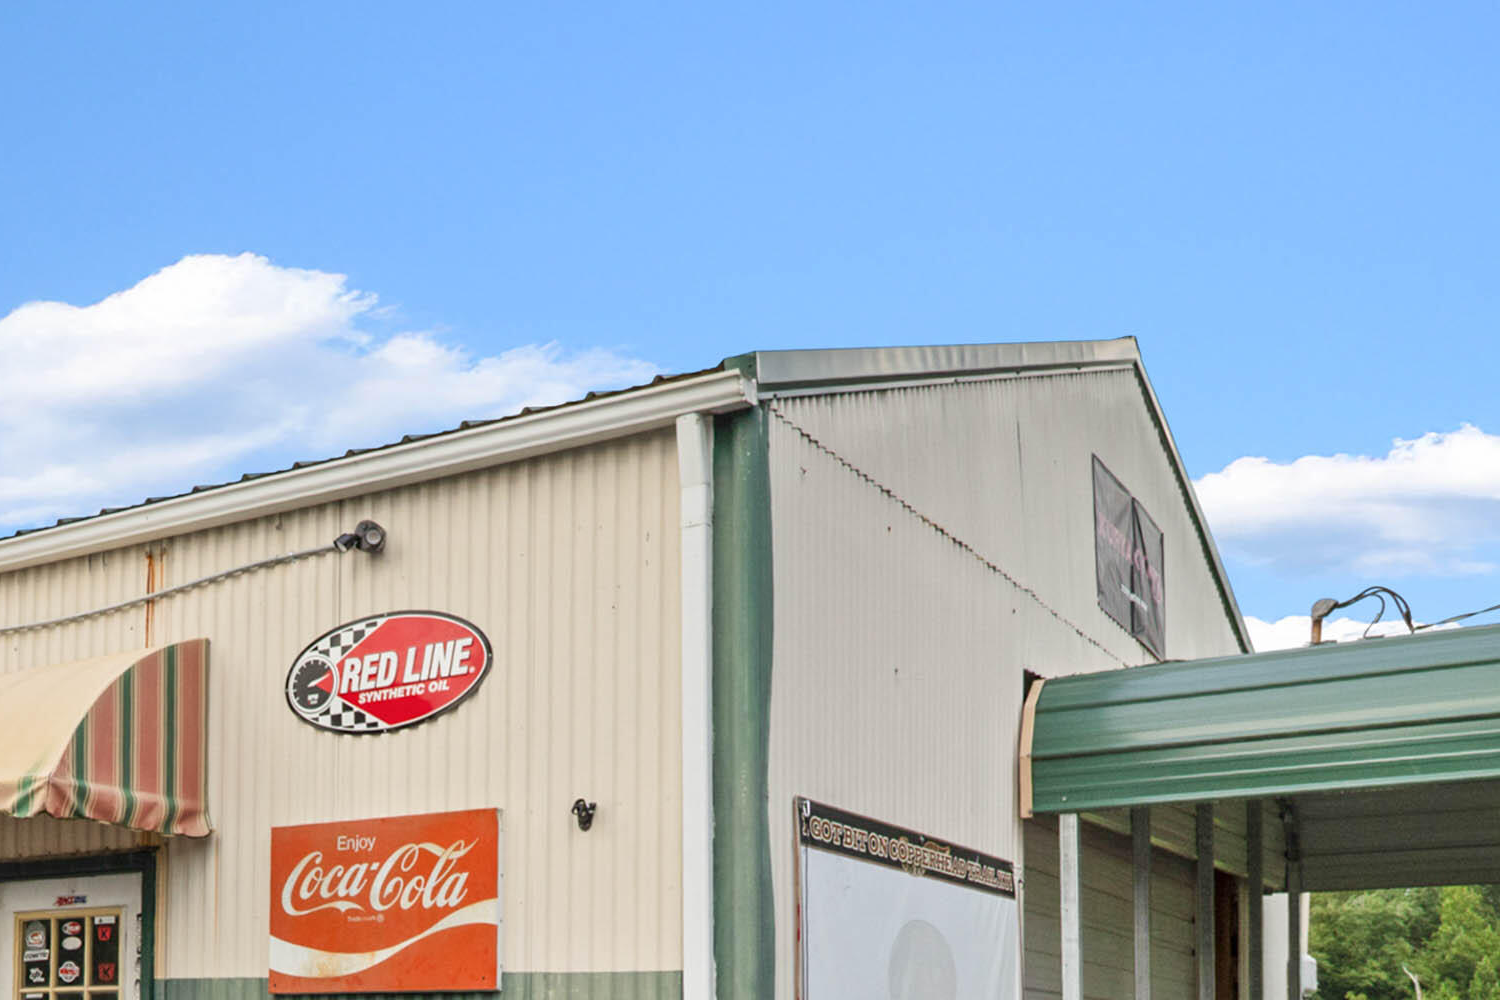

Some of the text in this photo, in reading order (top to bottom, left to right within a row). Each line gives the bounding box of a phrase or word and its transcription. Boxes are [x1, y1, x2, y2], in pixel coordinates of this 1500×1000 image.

[340, 651, 399, 694] RED
[358, 680, 450, 705] SYNTHETIC OIL
[337, 835, 376, 852] Enjoy
[810, 815, 842, 846] GOT
[843, 825, 868, 852] BIT
[868, 832, 888, 858] ON
[889, 838, 966, 879] COPPERHEAD
[281, 837, 479, 916] Coca-Cola
